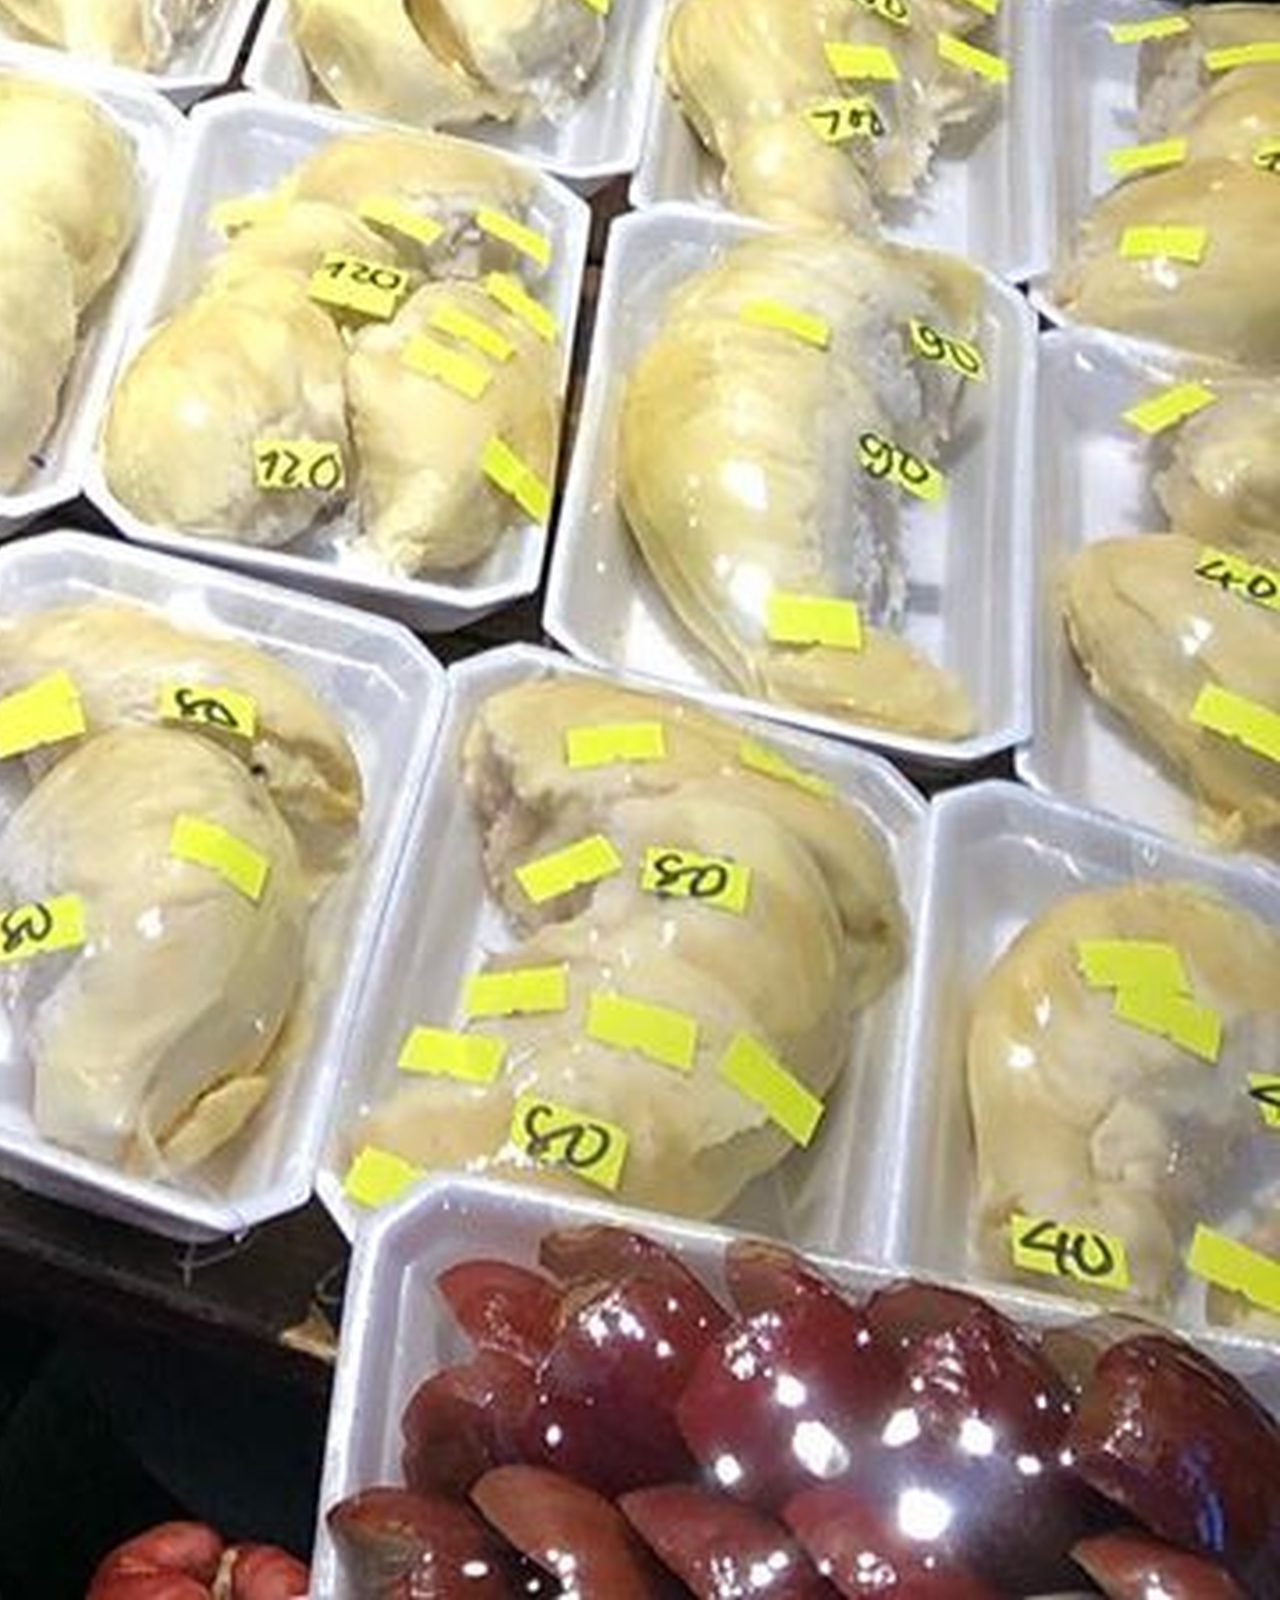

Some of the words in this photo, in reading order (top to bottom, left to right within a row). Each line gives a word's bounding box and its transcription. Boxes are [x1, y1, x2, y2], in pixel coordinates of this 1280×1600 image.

[327, 259, 400, 291] 120
[918, 325, 979, 373] 90
[859, 432, 929, 484] 90
[1195, 559, 1277, 599] 40
[525, 1105, 610, 1167] 80
[1018, 1220, 1115, 1278] 40
